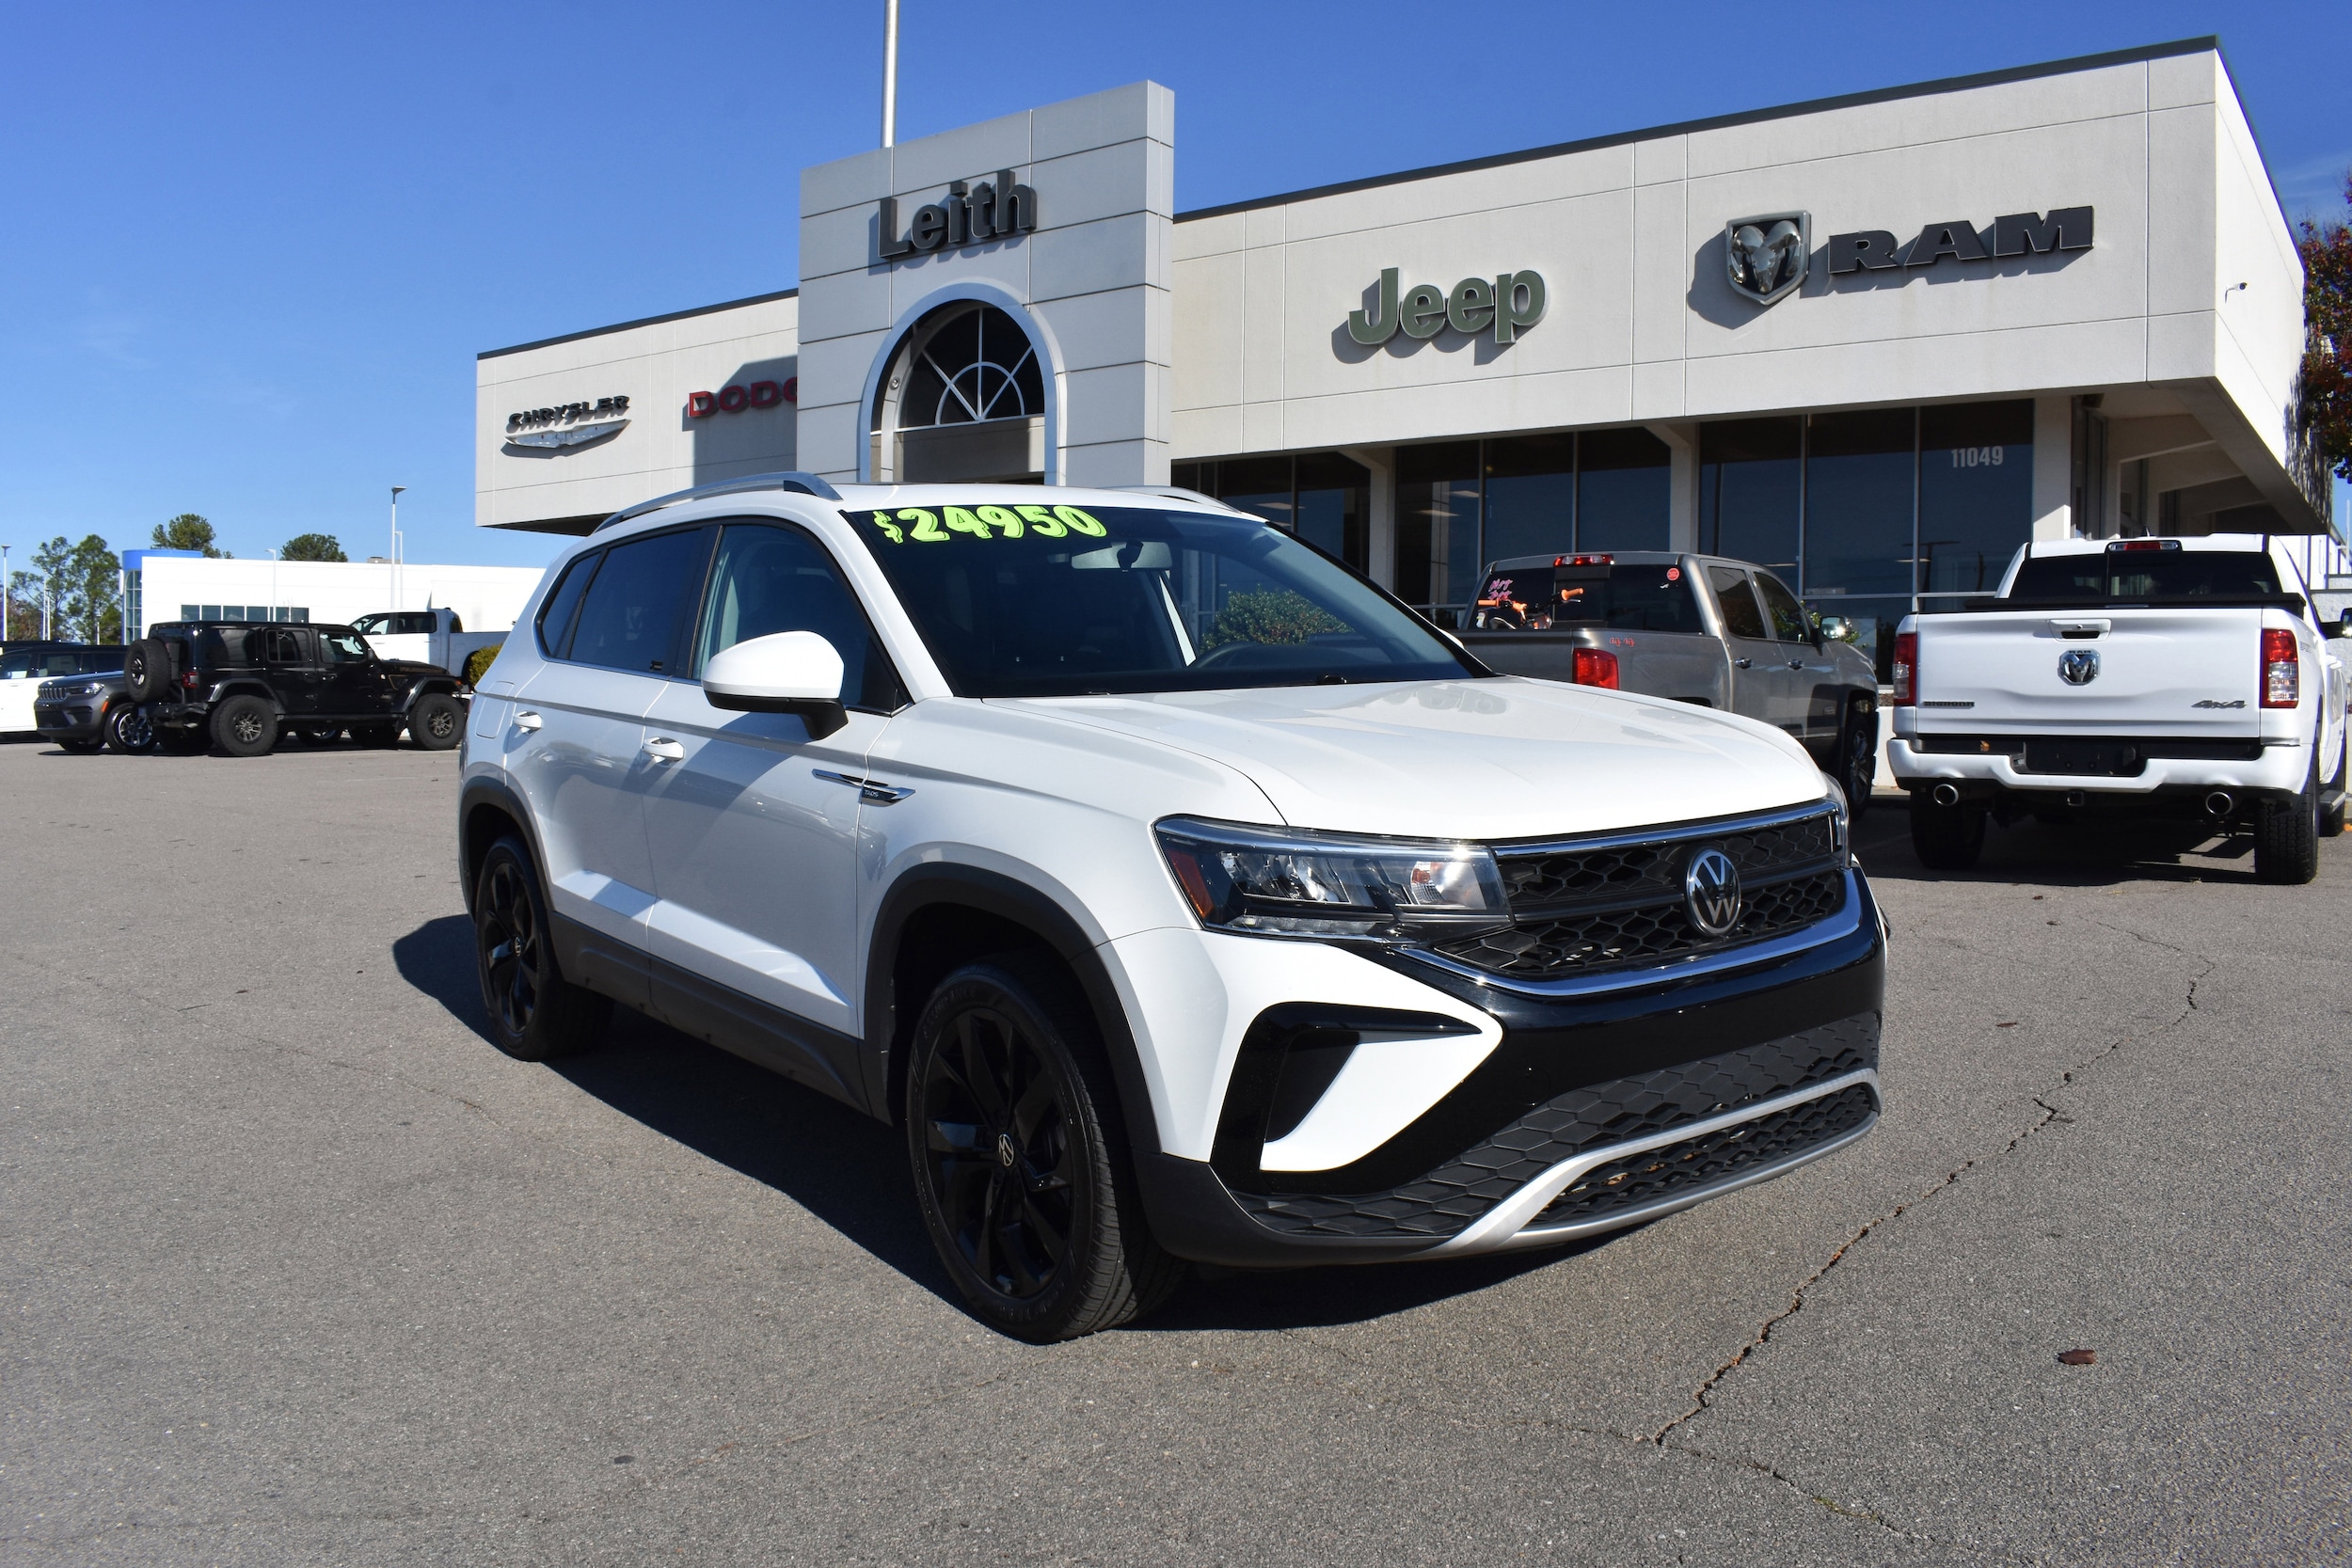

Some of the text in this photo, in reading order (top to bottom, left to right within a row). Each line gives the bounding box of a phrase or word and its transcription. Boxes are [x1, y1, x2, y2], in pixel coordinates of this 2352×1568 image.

[879, 168, 1037, 259] Leith
[1828, 206, 2093, 274] RAM
[1347, 267, 1550, 346] Jeep
[508, 395, 630, 426] CHRYSLER
[1951, 445, 2004, 467] 11049
[873, 505, 1107, 545] $24950
